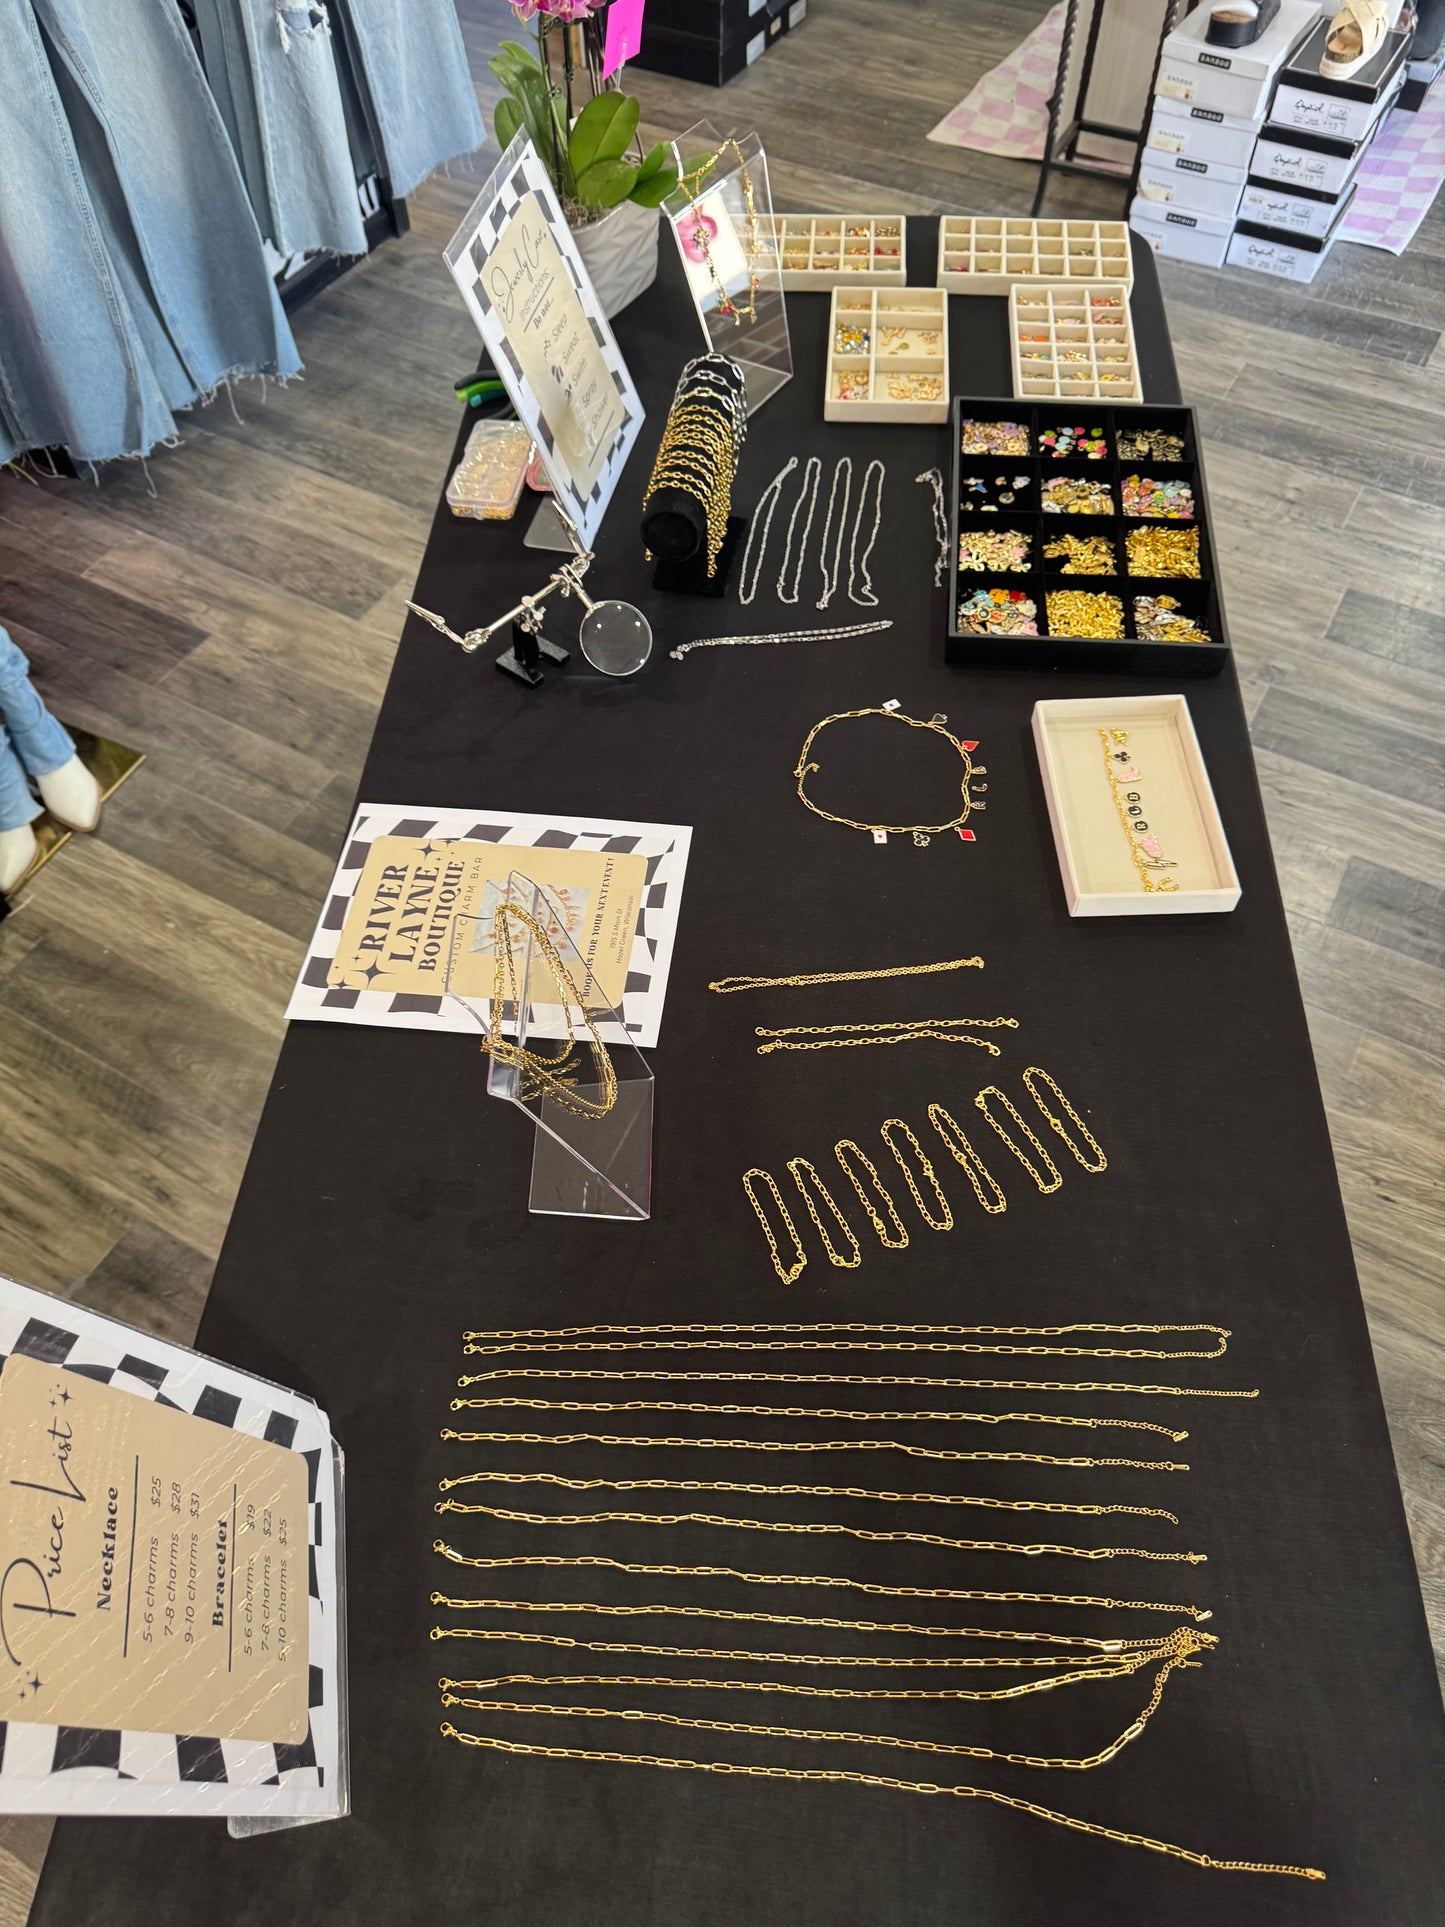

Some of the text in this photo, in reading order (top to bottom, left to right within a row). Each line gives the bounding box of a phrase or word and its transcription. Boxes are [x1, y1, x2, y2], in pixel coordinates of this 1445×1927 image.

[358, 864, 409, 952] RIVER
[460, 885, 475, 926] CARM
[471, 857, 483, 879] BAR
[597, 888, 608, 913] NEXT
[602, 858, 616, 888] EVENT!
[624, 895, 634, 924] Wisconsin
[388, 866, 440, 963] LAYNE
[417, 861, 465, 971] BOUTIQUE
[588, 939, 598, 956] FOR
[592, 913, 603, 937] YOUR
[0, 1415, 87, 1666] Price List
[96, 1486, 119, 1611] Necklace
[143, 1476, 162, 1643] 5-6 charms $25
[164, 1482, 181, 1637] 7-8 charms $28
[263, 1510, 272, 1537] $22
[279, 1518, 288, 1547] $25
[184, 1492, 200, 1643] 9-10 charms $31
[212, 1519, 228, 1627] Bracelet
[244, 1504, 256, 1656] 5-6 charms $19
[262, 1555, 271, 1620] charms
[278, 1559, 287, 1623] charms
